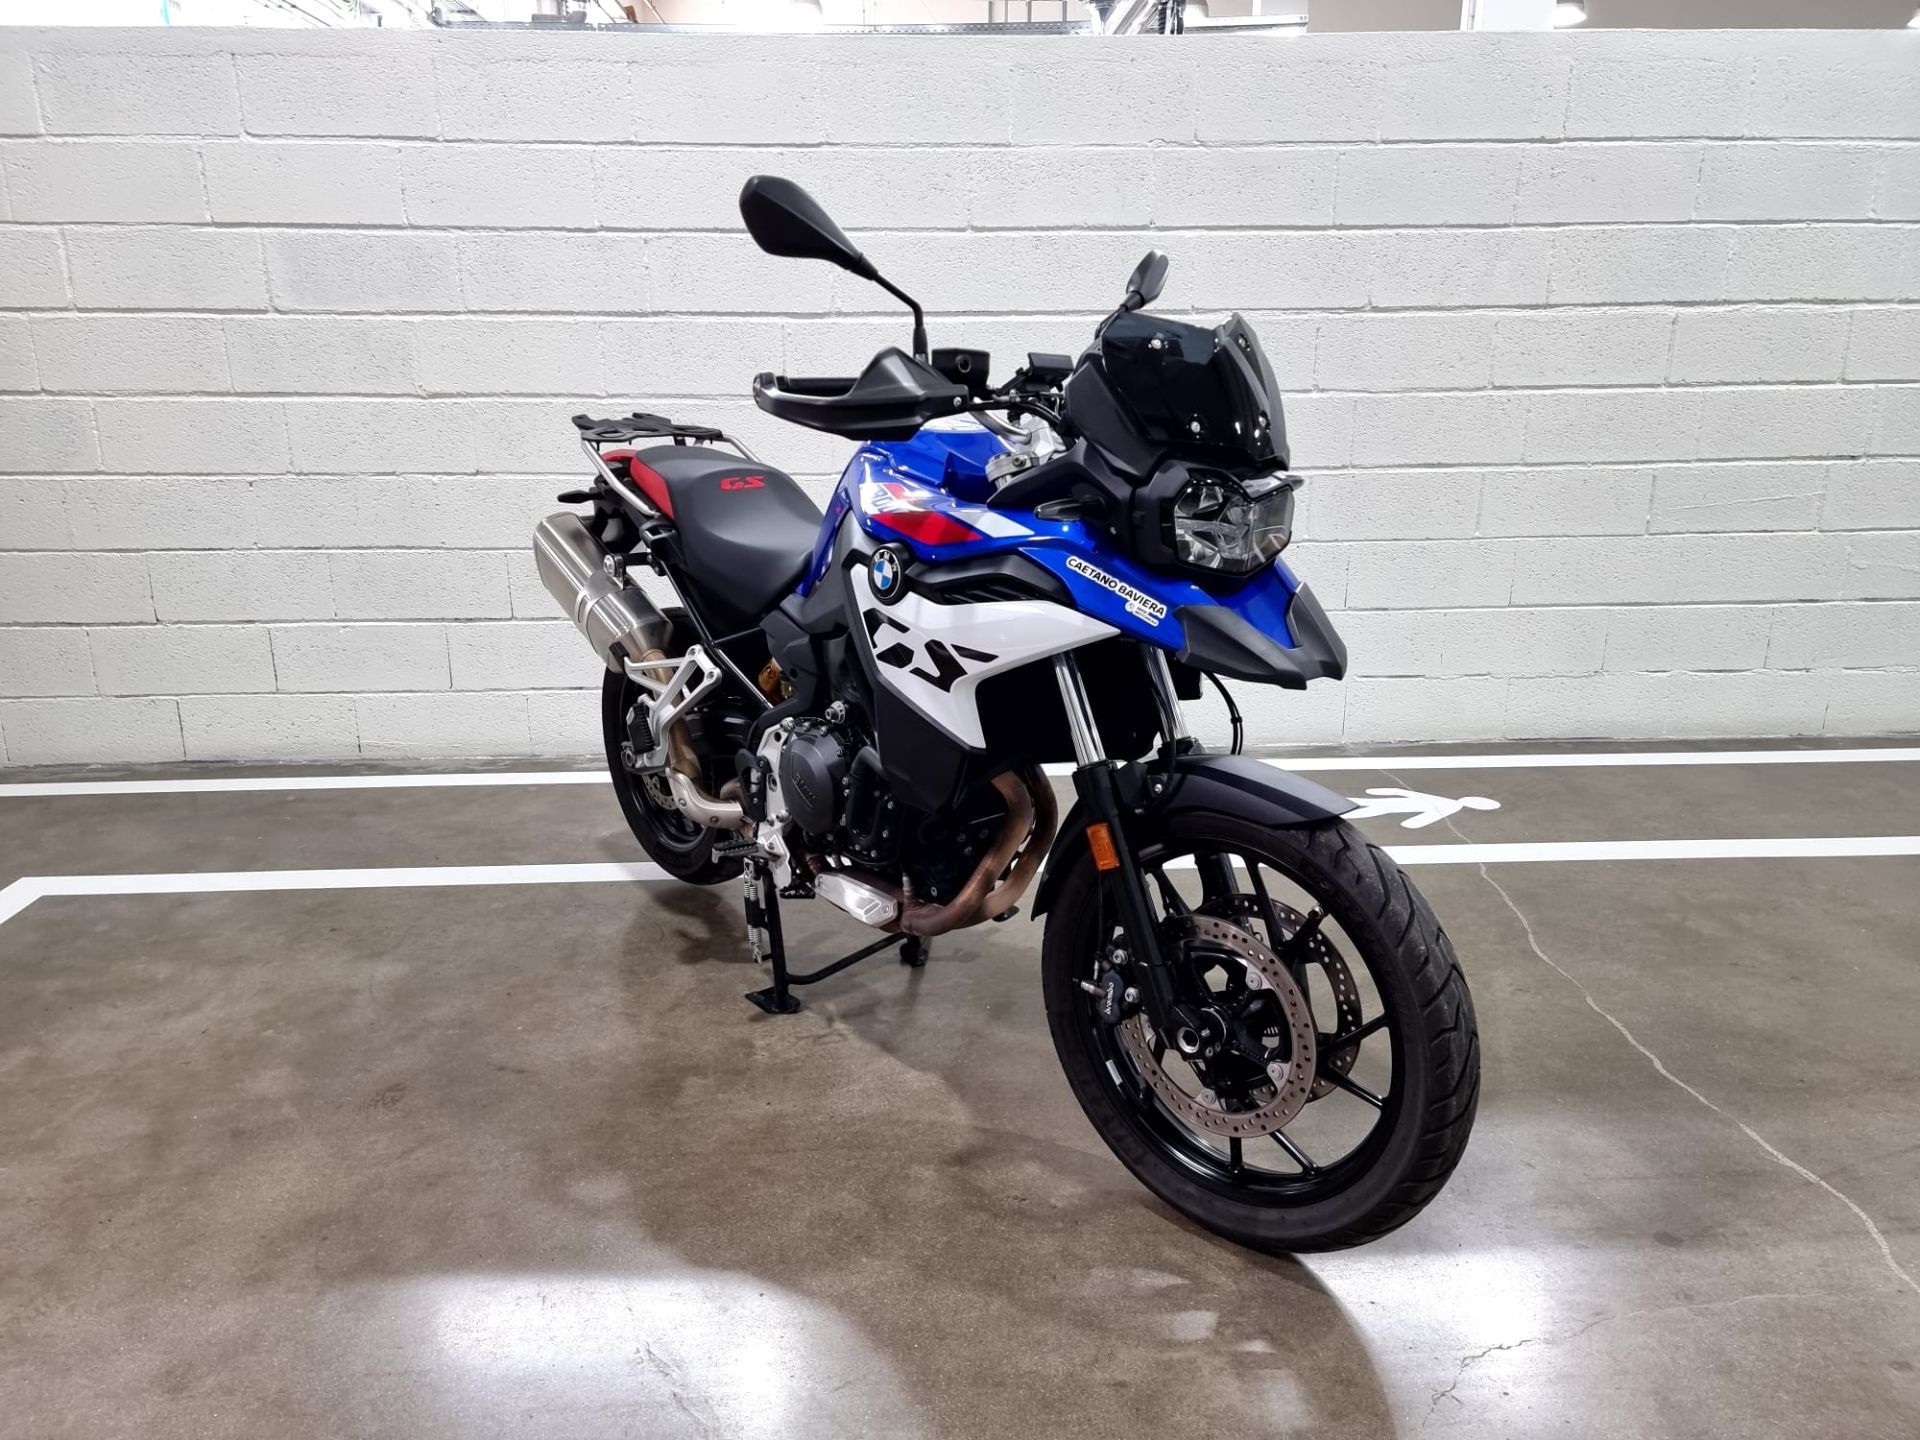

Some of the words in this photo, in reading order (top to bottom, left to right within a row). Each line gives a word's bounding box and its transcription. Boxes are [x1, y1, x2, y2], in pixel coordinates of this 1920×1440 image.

[719, 475, 765, 491] GS
[874, 551, 897, 572] BMW
[1068, 557, 1118, 589] CAETANO
[1118, 584, 1165, 617] BAVIERA
